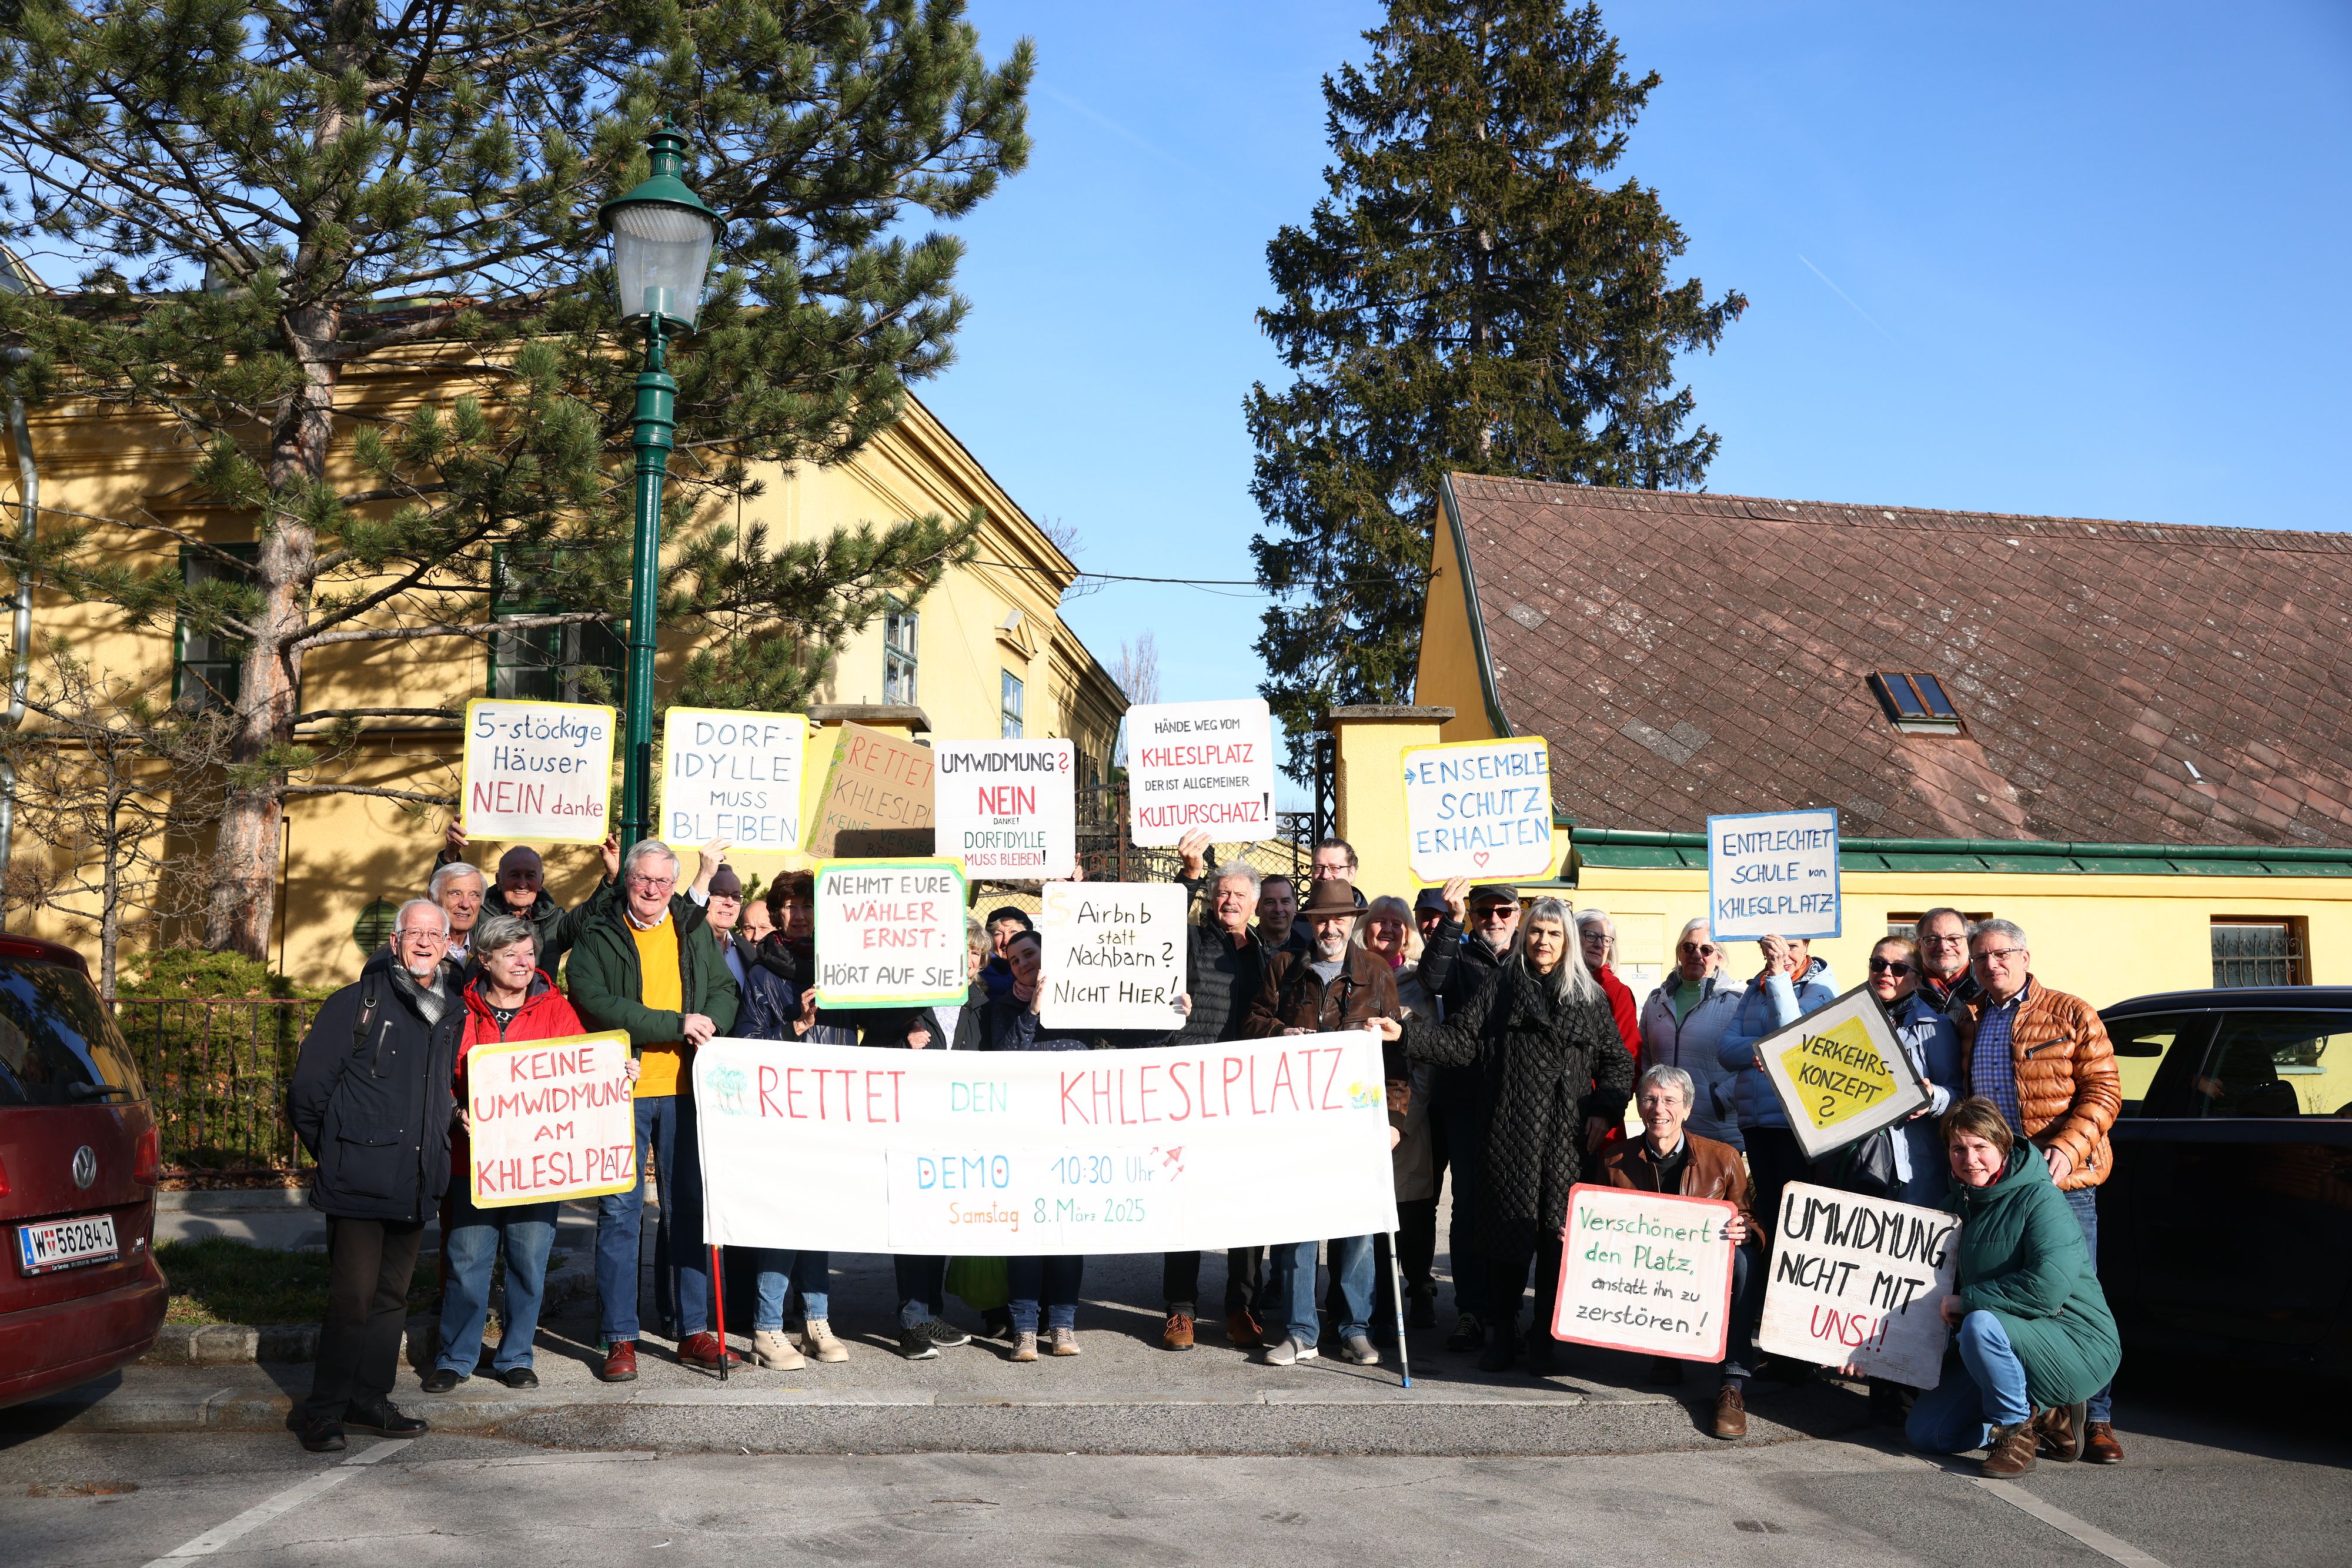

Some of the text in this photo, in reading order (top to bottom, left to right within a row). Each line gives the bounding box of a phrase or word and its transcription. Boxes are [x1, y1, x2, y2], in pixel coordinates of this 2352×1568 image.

[475, 713, 602, 747] 5-stöckige
[696, 723, 793, 747] DORF-
[1155, 718, 1240, 733] HÄNDE WEG VOM
[494, 745, 587, 773] Häuser
[675, 753, 791, 781] IDYLLE
[848, 736, 934, 788] RETTET
[1142, 744, 1254, 767] KHLESLPLATZ
[1419, 752, 1549, 784] ENSEMBLE
[1145, 776, 1250, 791] DER IST ALLGEMEINER
[473, 781, 603, 817] NEIN danke
[711, 791, 767, 808] MUSS
[834, 774, 935, 833] KHLESLPL
[979, 786, 1035, 815] NEIN
[1437, 787, 1542, 820] SCHUTZ
[673, 813, 797, 842] BLEIBEN
[827, 811, 870, 835] KEINE
[1417, 817, 1549, 853] ERHALTEN
[964, 831, 1045, 848] DORFIDYLLE
[1723, 828, 1835, 856] ENTFLECHTET
[965, 850, 1045, 865] MUSS BLEIBEN!
[827, 875, 950, 895] NEHMT EURE
[1730, 861, 1800, 884] SCHULE
[843, 900, 938, 922] WÄHLER
[1078, 901, 1151, 924] Airbnb
[1719, 894, 1835, 920] KHLESLPLATZ
[1097, 930, 1135, 945] statt
[1067, 942, 1174, 968] Nachbarn?
[876, 967, 914, 985] AUF
[1054, 980, 1110, 1004] NICHT
[511, 1048, 595, 1082] KEINE
[759, 1047, 1344, 1125] RETTET DEN KHLESLPLATZ
[1798, 1062, 1883, 1103] KONZEPT
[474, 1076, 631, 1122] UMWIDMUNG
[1819, 1095, 1835, 1125] ?
[534, 1121, 573, 1142] AM
[477, 1145, 634, 1195] KHLESLPLATZ
[917, 1155, 1155, 1189] DEMO 10:30 Uhr
[949, 1198, 1146, 1233] Samstag 8. März 2025
[1579, 1206, 1712, 1243] Verschönert
[32, 1231, 46, 1258] W
[1783, 1193, 1955, 1270] UMWIDMUNG
[1585, 1241, 1694, 1275] den Platz,
[1591, 1277, 1700, 1302] anstatt ihn zu
[1776, 1251, 1925, 1315] NICHT MIT
[1810, 1305, 1889, 1353] UNS!!
